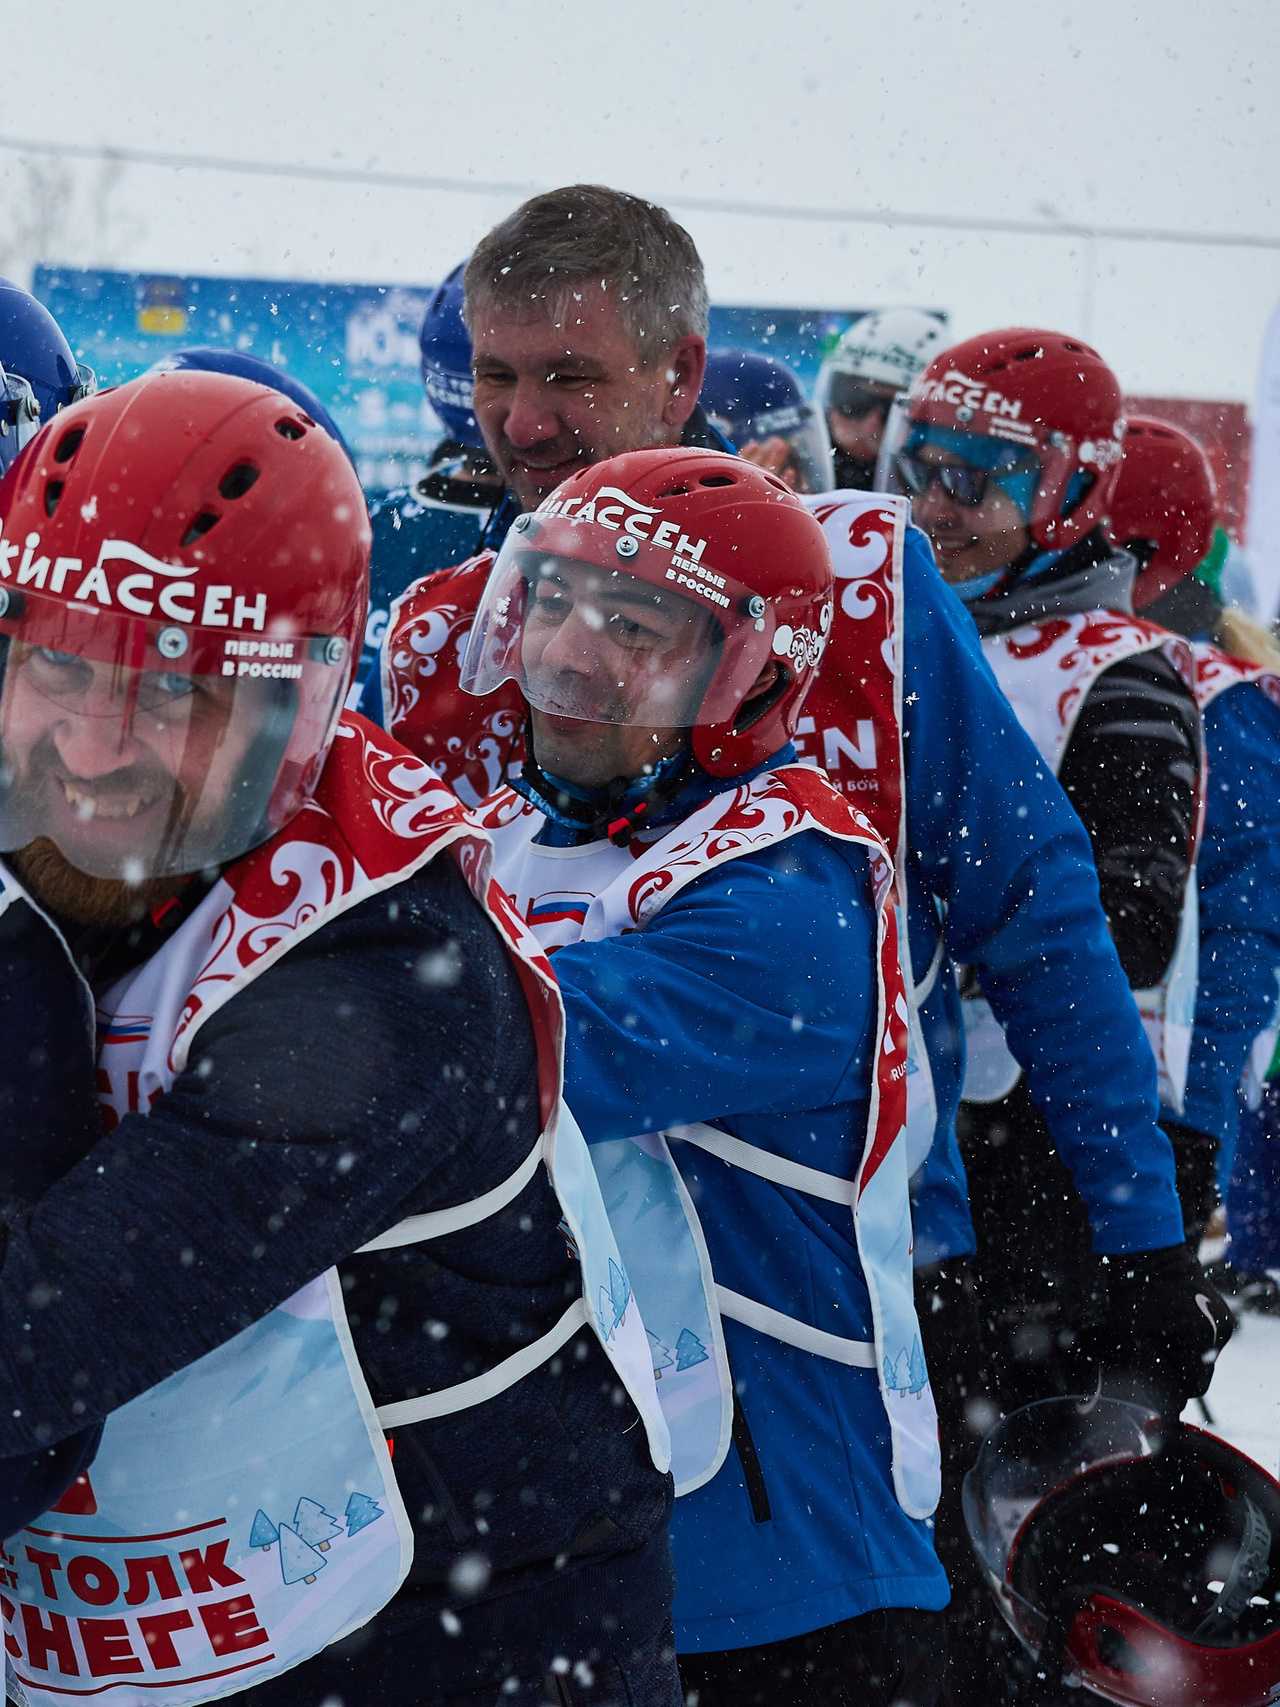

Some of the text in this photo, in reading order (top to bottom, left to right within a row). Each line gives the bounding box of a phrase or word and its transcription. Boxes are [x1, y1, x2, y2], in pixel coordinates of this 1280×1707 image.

[665, 568, 731, 609] В РОССИИ
[671, 554, 727, 590] ПЕРВЫЕ
[224, 639, 295, 659] ПЕРВЫЕ
[222, 660, 303, 679] В РОССИИ
[25, 1538, 246, 1606] ТОЛК
